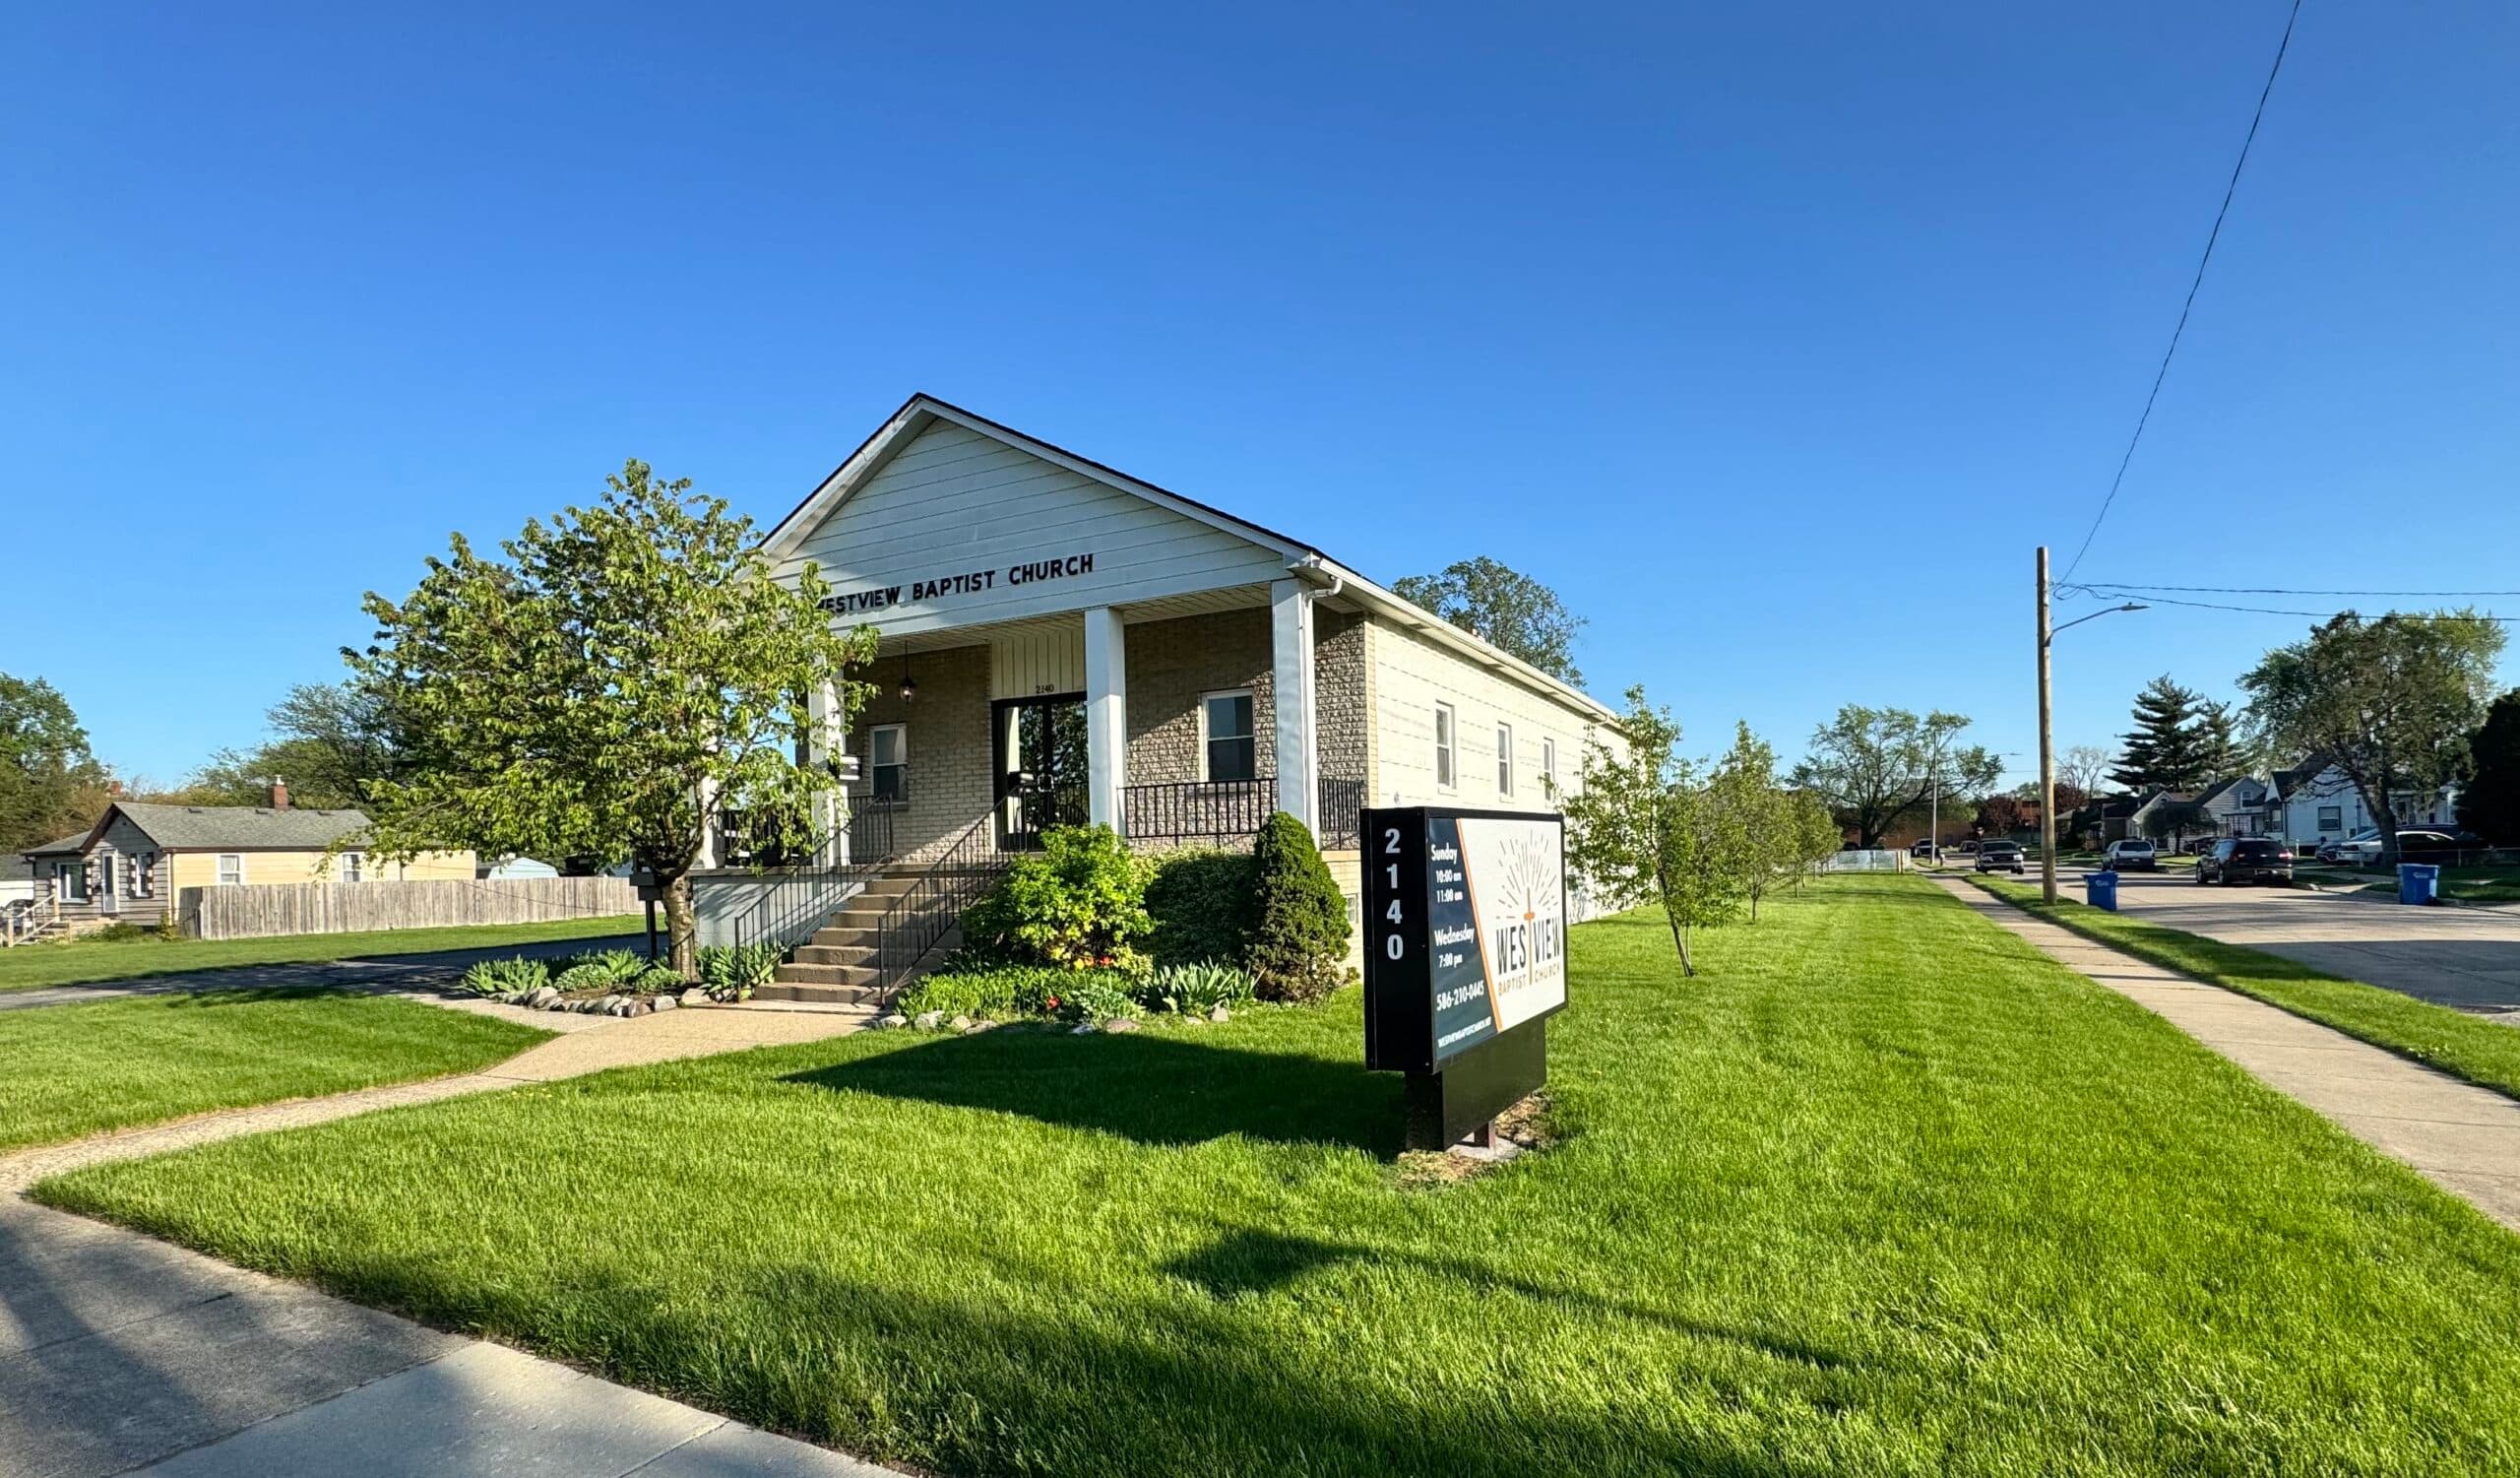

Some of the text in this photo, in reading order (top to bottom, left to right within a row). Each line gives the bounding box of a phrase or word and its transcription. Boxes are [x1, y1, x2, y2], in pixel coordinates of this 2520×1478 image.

[913, 570, 996, 601] BAPTIST
[1009, 554, 1094, 585] CHURCH
[1431, 842, 1457, 865] Sunday
[1436, 869, 1453, 883] 10:00
[1437, 888, 1454, 903] 11:00
[1434, 923, 1475, 946] Wednesday
[1439, 952, 1453, 968] 7:00
[1498, 961, 1560, 996] BAPTIST CHURCH
[1436, 980, 1484, 1012] 586-210-0445
